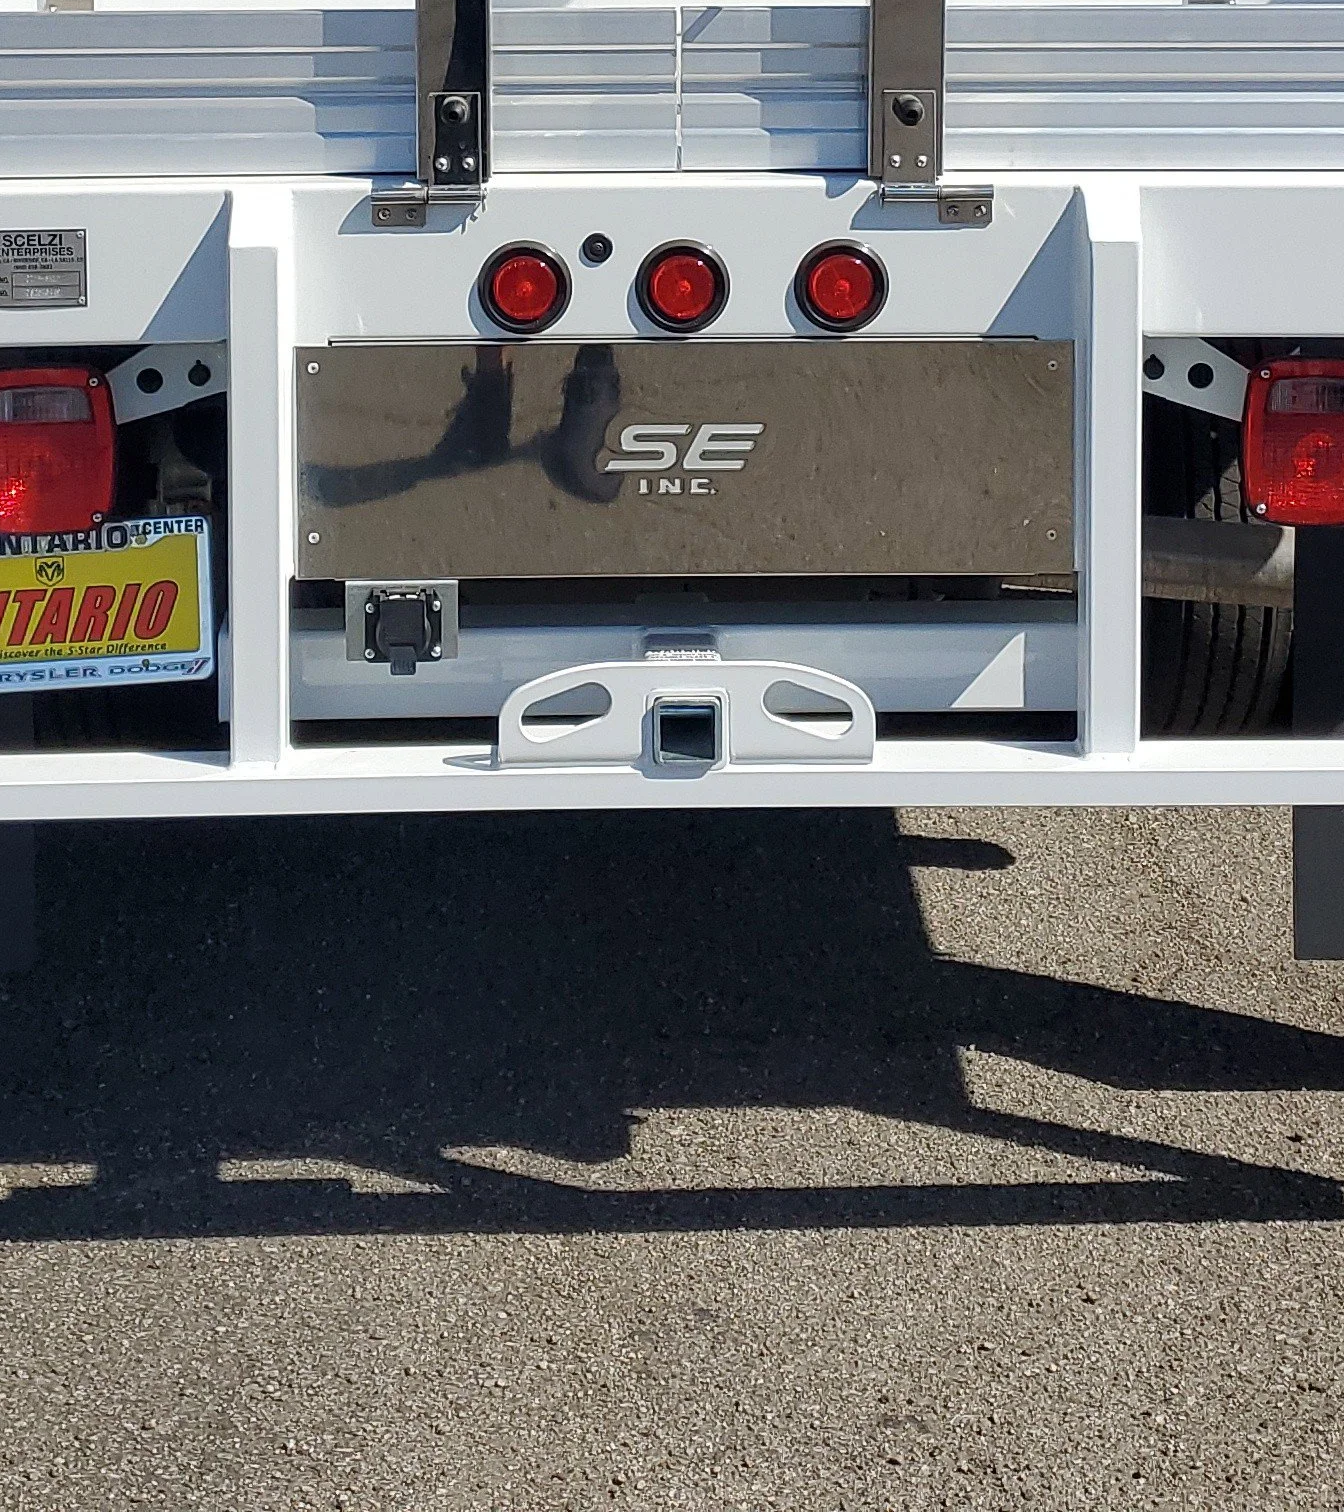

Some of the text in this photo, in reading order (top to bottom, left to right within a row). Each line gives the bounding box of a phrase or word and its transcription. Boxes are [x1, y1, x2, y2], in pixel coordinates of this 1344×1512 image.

[2, 233, 63, 247] SCELZI
[605, 423, 766, 472] SE
[141, 518, 204, 536] CENTER
[44, 645, 63, 656] the
[106, 641, 167, 655] Difference
